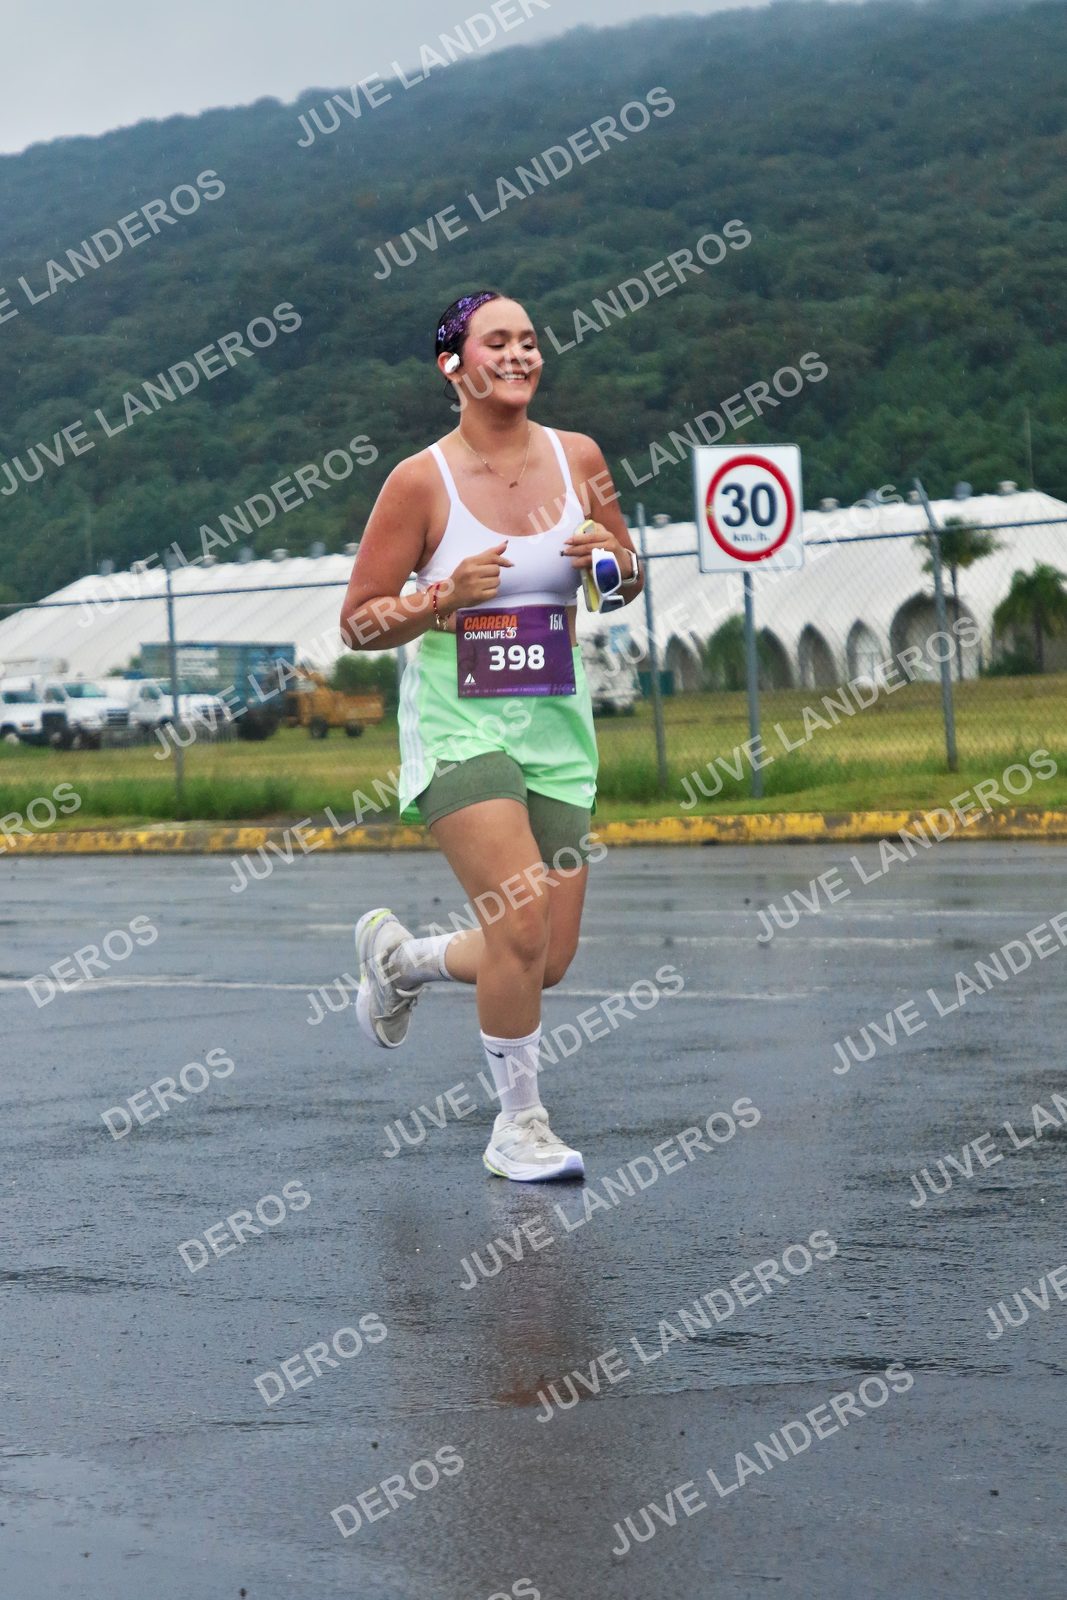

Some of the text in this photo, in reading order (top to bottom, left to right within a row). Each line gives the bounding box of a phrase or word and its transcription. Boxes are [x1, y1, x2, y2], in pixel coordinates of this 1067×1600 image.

[721, 482, 777, 527] 30
[463, 614, 517, 631] CARRERA
[549, 613, 564, 631] 15K
[488, 644, 545, 671] 398
